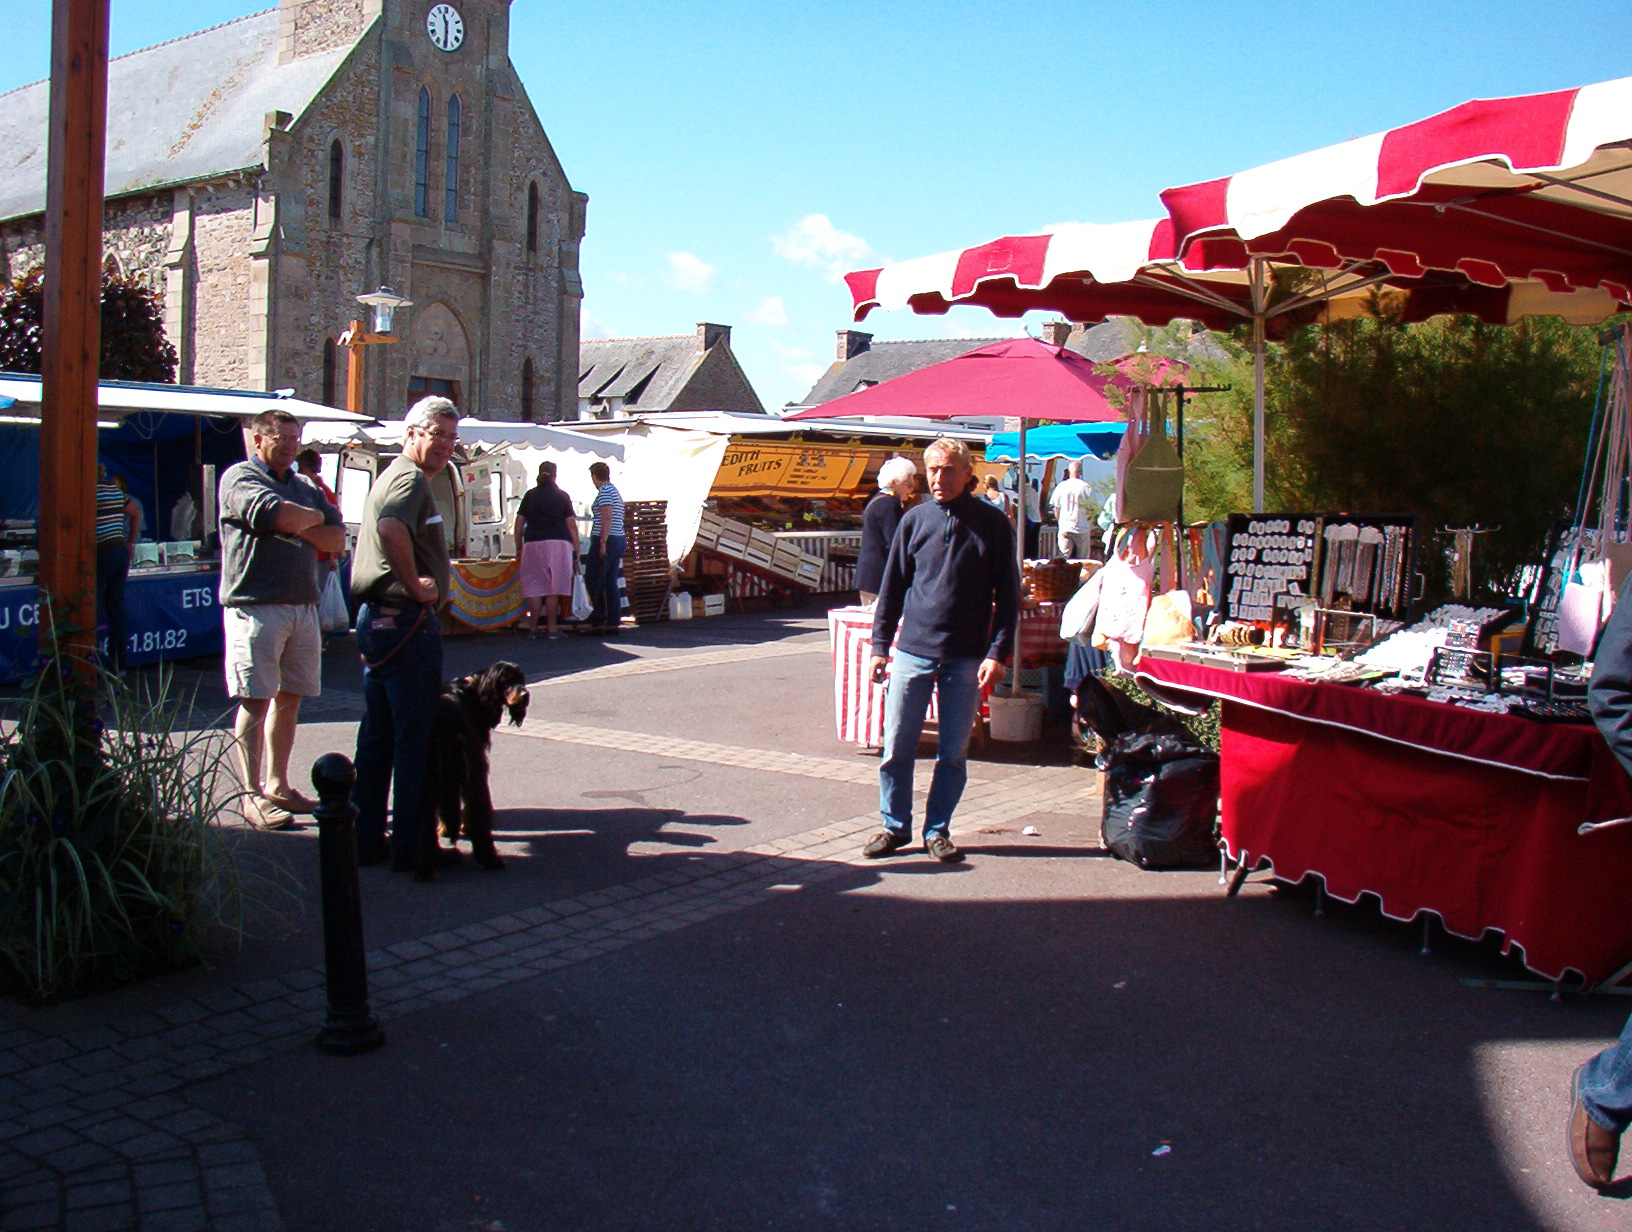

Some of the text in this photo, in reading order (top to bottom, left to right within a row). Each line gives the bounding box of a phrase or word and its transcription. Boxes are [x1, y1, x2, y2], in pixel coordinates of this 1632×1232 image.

[722, 450, 761, 466] EDITH
[738, 459, 783, 477] FRUITS
[182, 587, 212, 609] ETS
